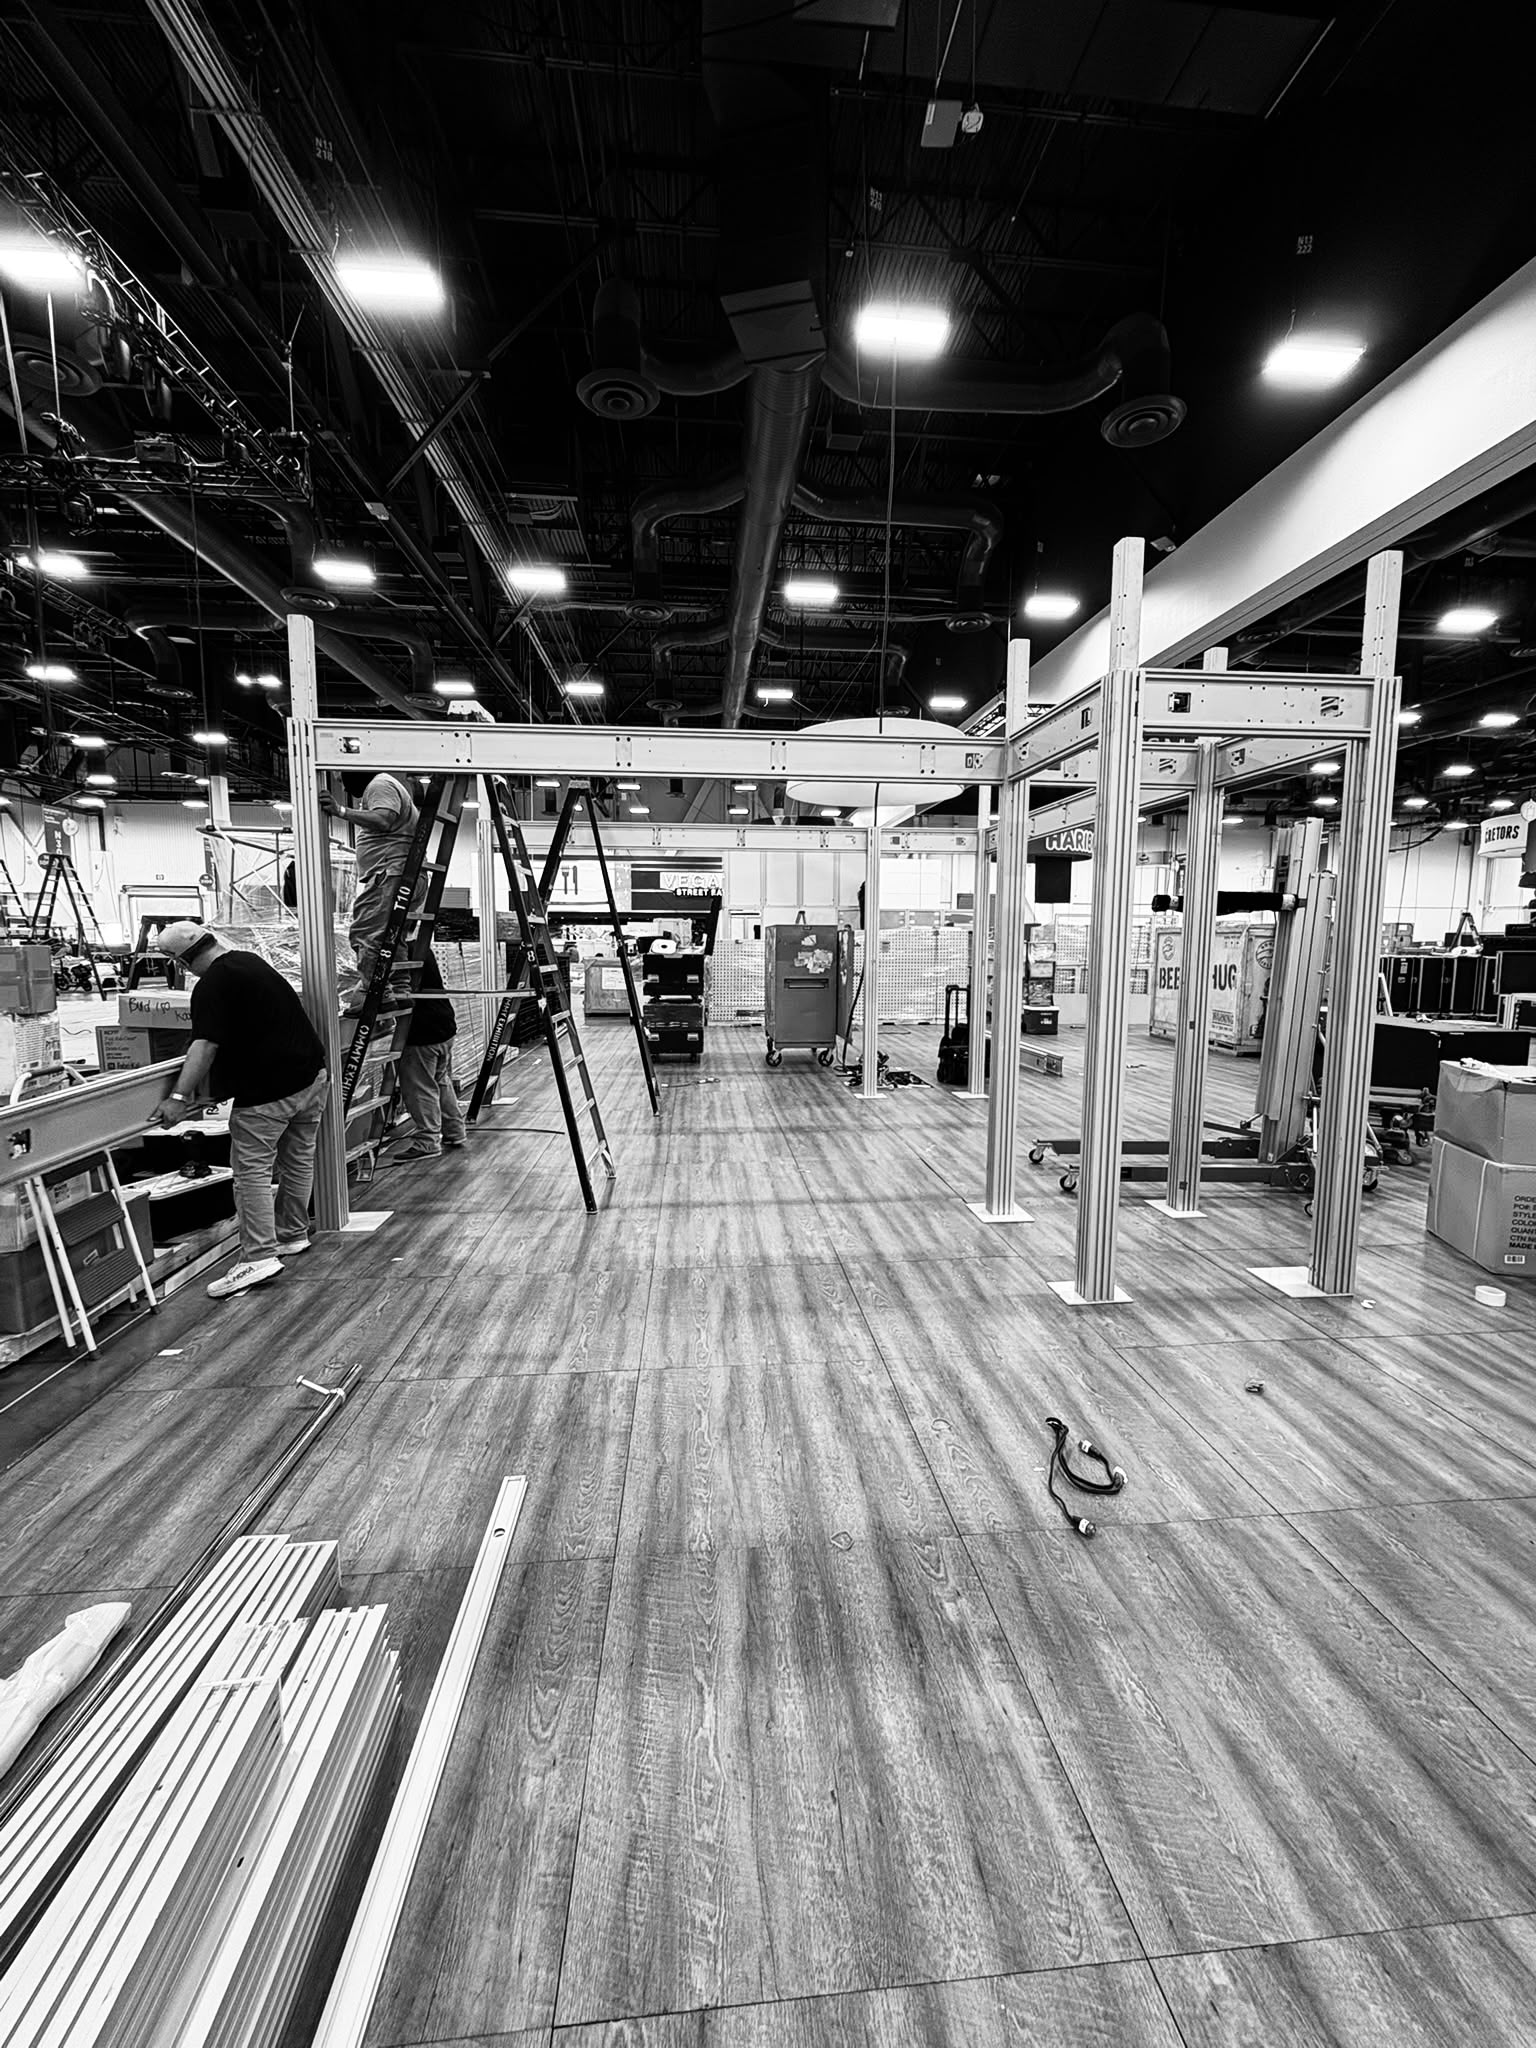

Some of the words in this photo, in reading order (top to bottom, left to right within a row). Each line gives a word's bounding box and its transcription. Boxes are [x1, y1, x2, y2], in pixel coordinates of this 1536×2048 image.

[676, 888, 709, 896] STREET
[393, 885, 412, 911] T10
[379, 949, 392, 958] 8
[527, 950, 536, 962] 8
